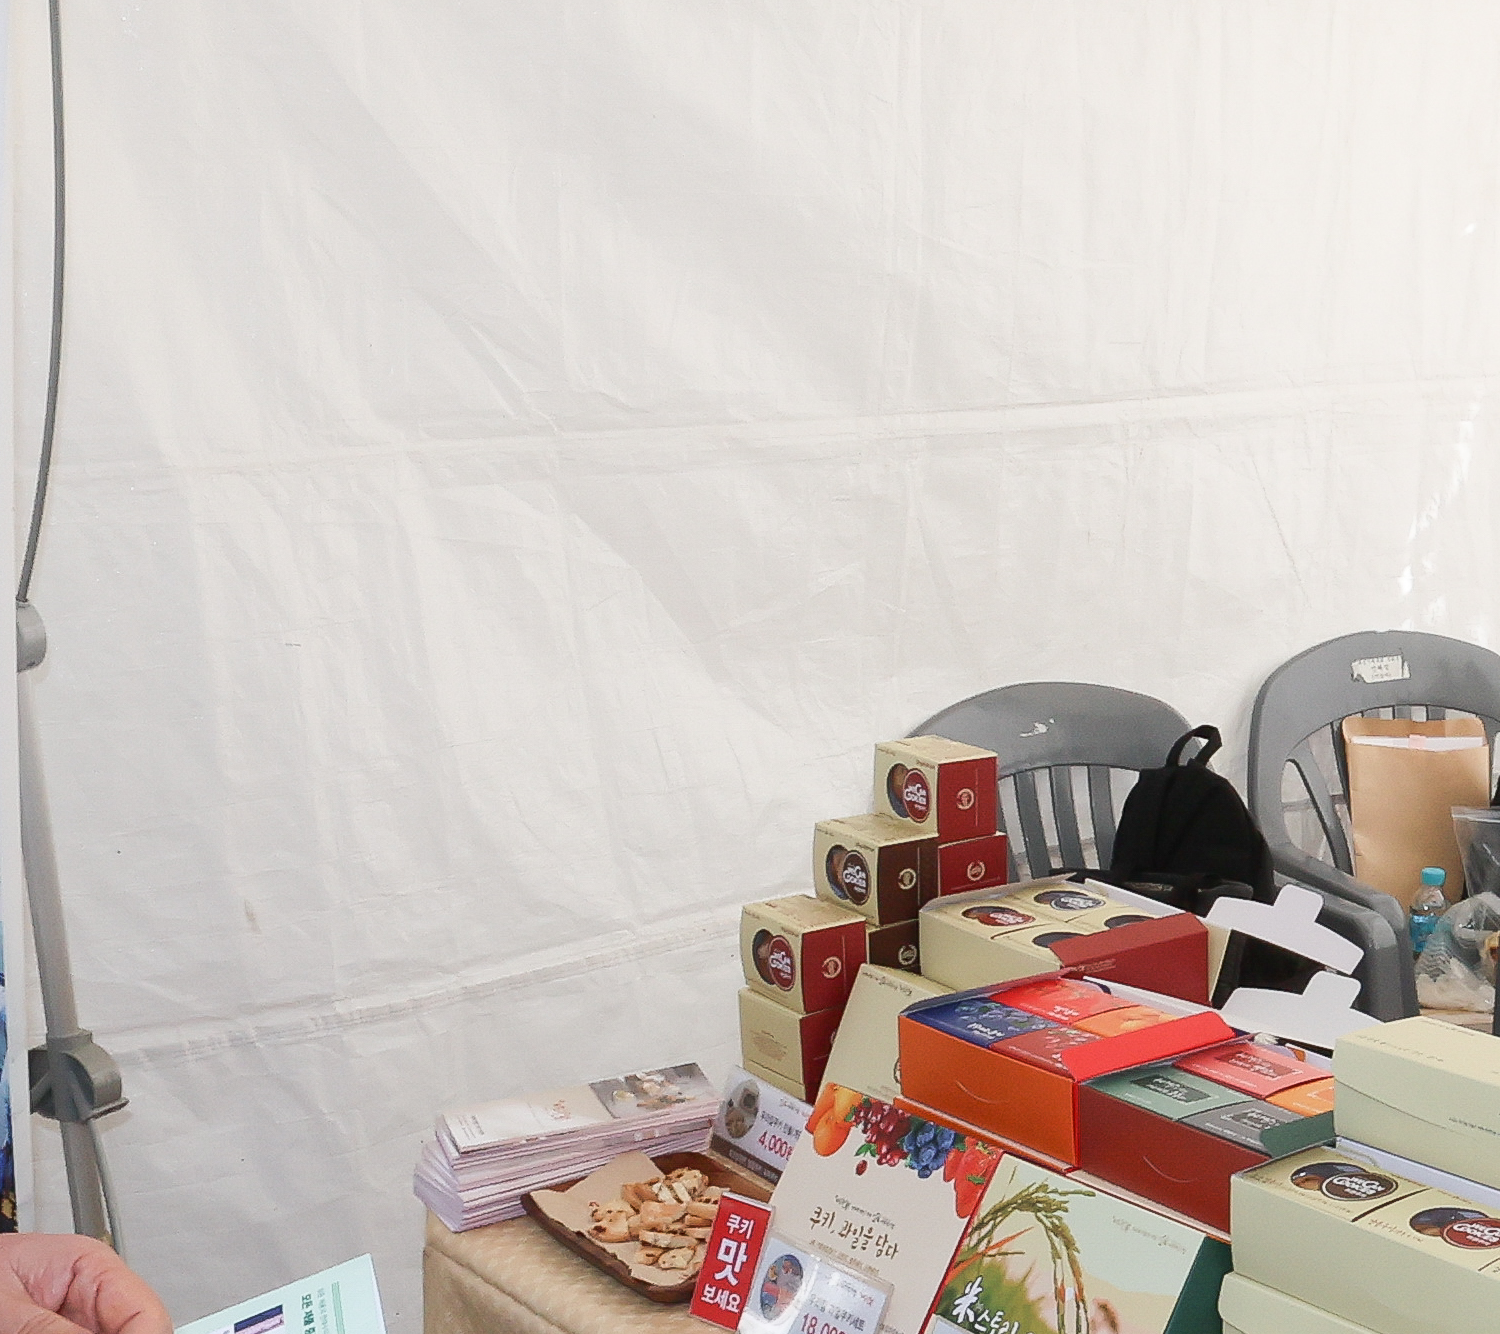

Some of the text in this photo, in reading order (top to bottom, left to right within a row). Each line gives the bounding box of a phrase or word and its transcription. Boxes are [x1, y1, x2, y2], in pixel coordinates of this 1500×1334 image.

[726, 1213, 756, 1240] 쿠키
[713, 1237, 748, 1287] 맛
[700, 1283, 742, 1315] 보세요
